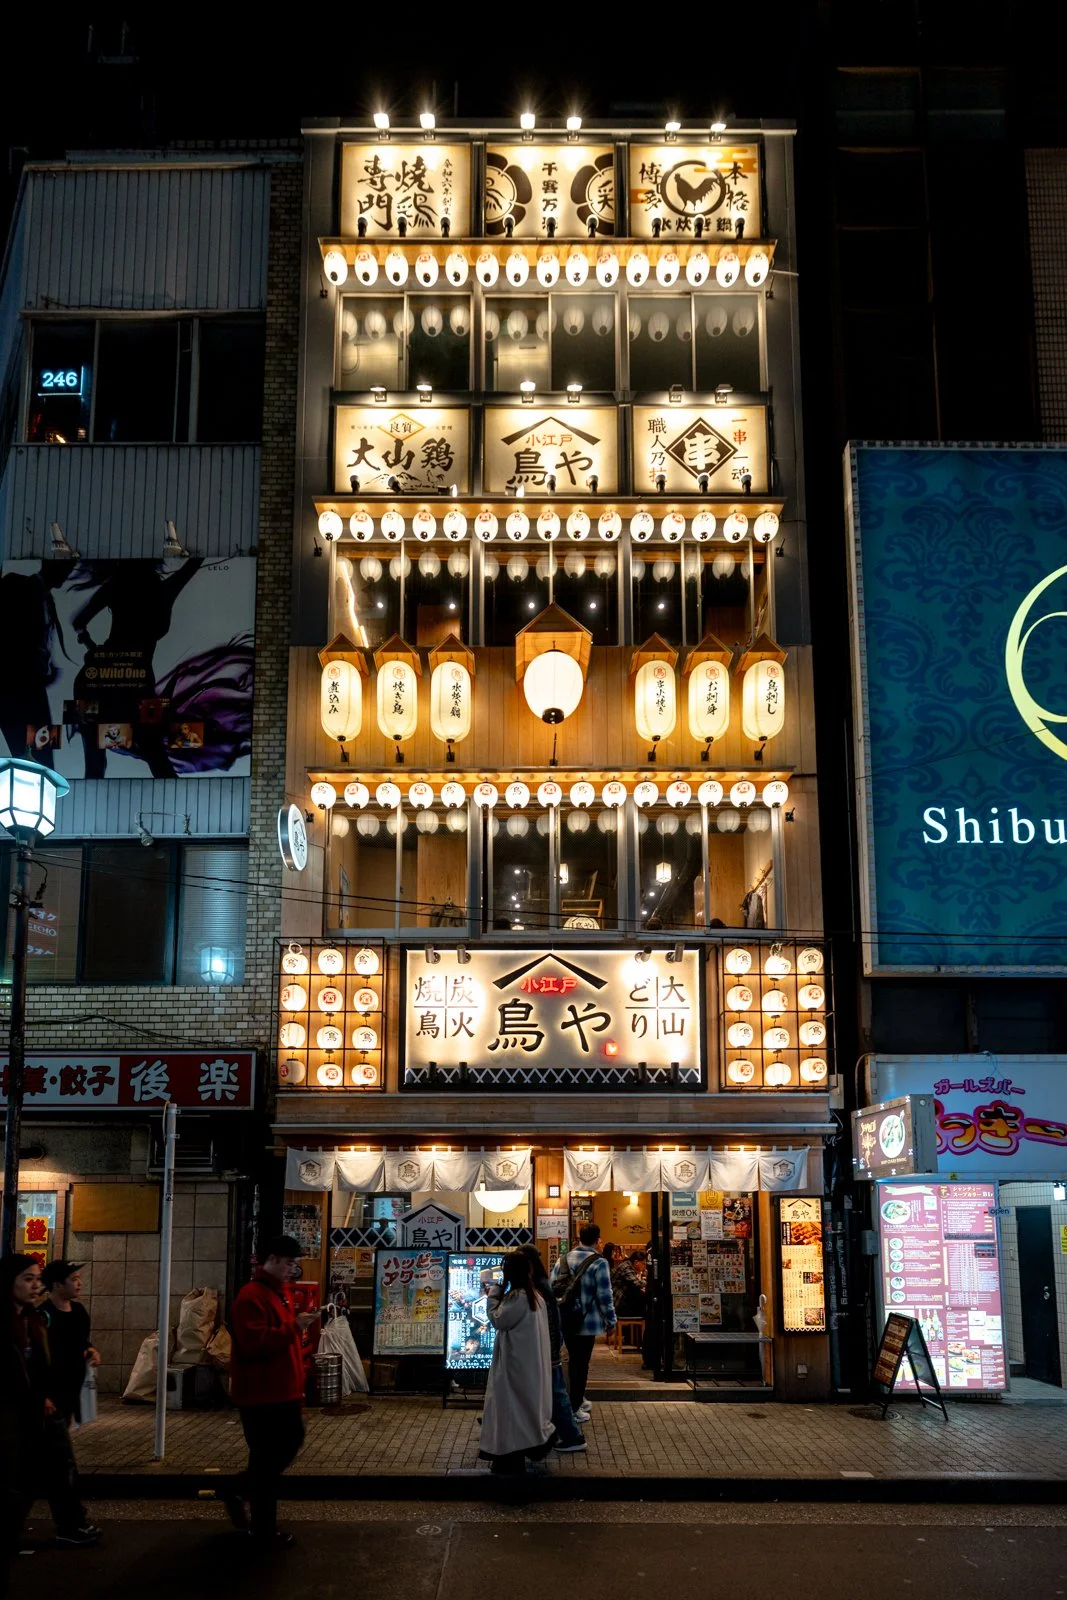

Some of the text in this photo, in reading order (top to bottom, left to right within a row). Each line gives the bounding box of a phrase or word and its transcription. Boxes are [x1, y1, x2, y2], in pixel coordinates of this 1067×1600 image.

[542, 162, 558, 229] 千客万
[42, 371, 78, 387] 246
[526, 434, 572, 447] 小江戸
[347, 437, 455, 471] 大山鶏
[505, 447, 594, 486] 鳥や
[99, 667, 147, 679] Wild One
[923, 806, 1067, 844] Shibu
[520, 975, 577, 994] 小江戸
[414, 975, 440, 1039] 焼鳥
[448, 975, 476, 1038] 炭火
[629, 977, 651, 1039] どり
[661, 975, 686, 1037] 大山
[487, 997, 612, 1053] 鳥や
[933, 1077, 1026, 1096] ガールズバー
[302, 1163, 318, 1176] 鳥
[402, 1163, 419, 1177] 鳥
[499, 1163, 515, 1177] 鳥
[580, 1162, 596, 1177] 鳥
[678, 1163, 693, 1177] 鳥
[777, 1162, 792, 1177] 鳥
[418, 1216, 443, 1224] 小江戸
[989, 1207, 1010, 1217] open
[411, 1227, 453, 1248] 鳥や
[383, 1253, 443, 1270] ハッピー
[475, 1258, 503, 1266] 2F/3F
[383, 1270, 428, 1286] アワー
[449, 1312, 468, 1321] B1F
